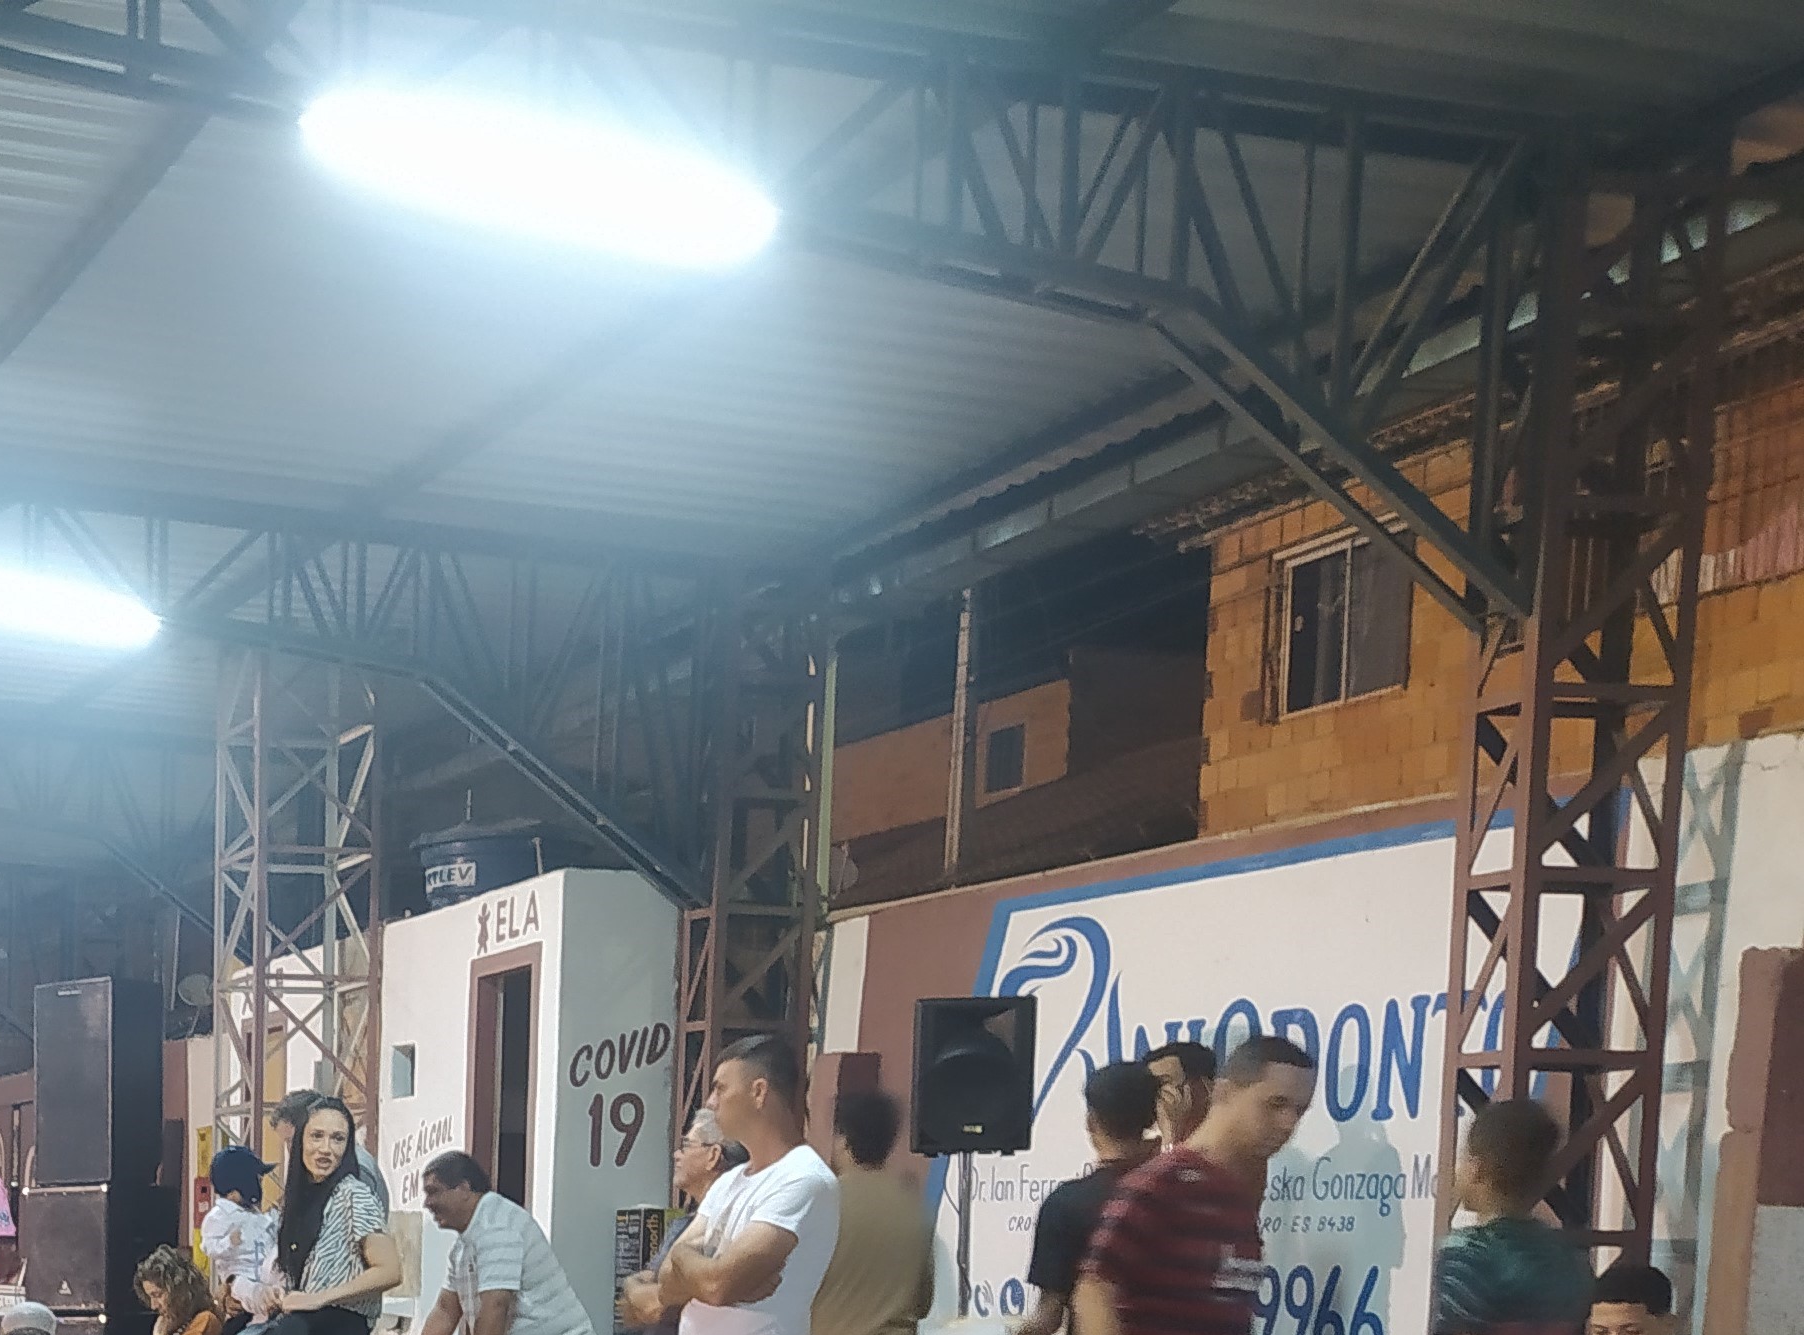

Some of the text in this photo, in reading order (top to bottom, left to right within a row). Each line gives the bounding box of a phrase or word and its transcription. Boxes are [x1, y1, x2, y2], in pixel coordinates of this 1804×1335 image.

[496, 890, 539, 943] ELA
[569, 1022, 671, 1088] COVID
[392, 1135, 413, 1170] USE
[589, 1093, 645, 1168] 19
[402, 1169, 420, 1204] EM
[1312, 1157, 1407, 1217] Gonzaga
[1317, 1216, 1355, 1232] 8438
